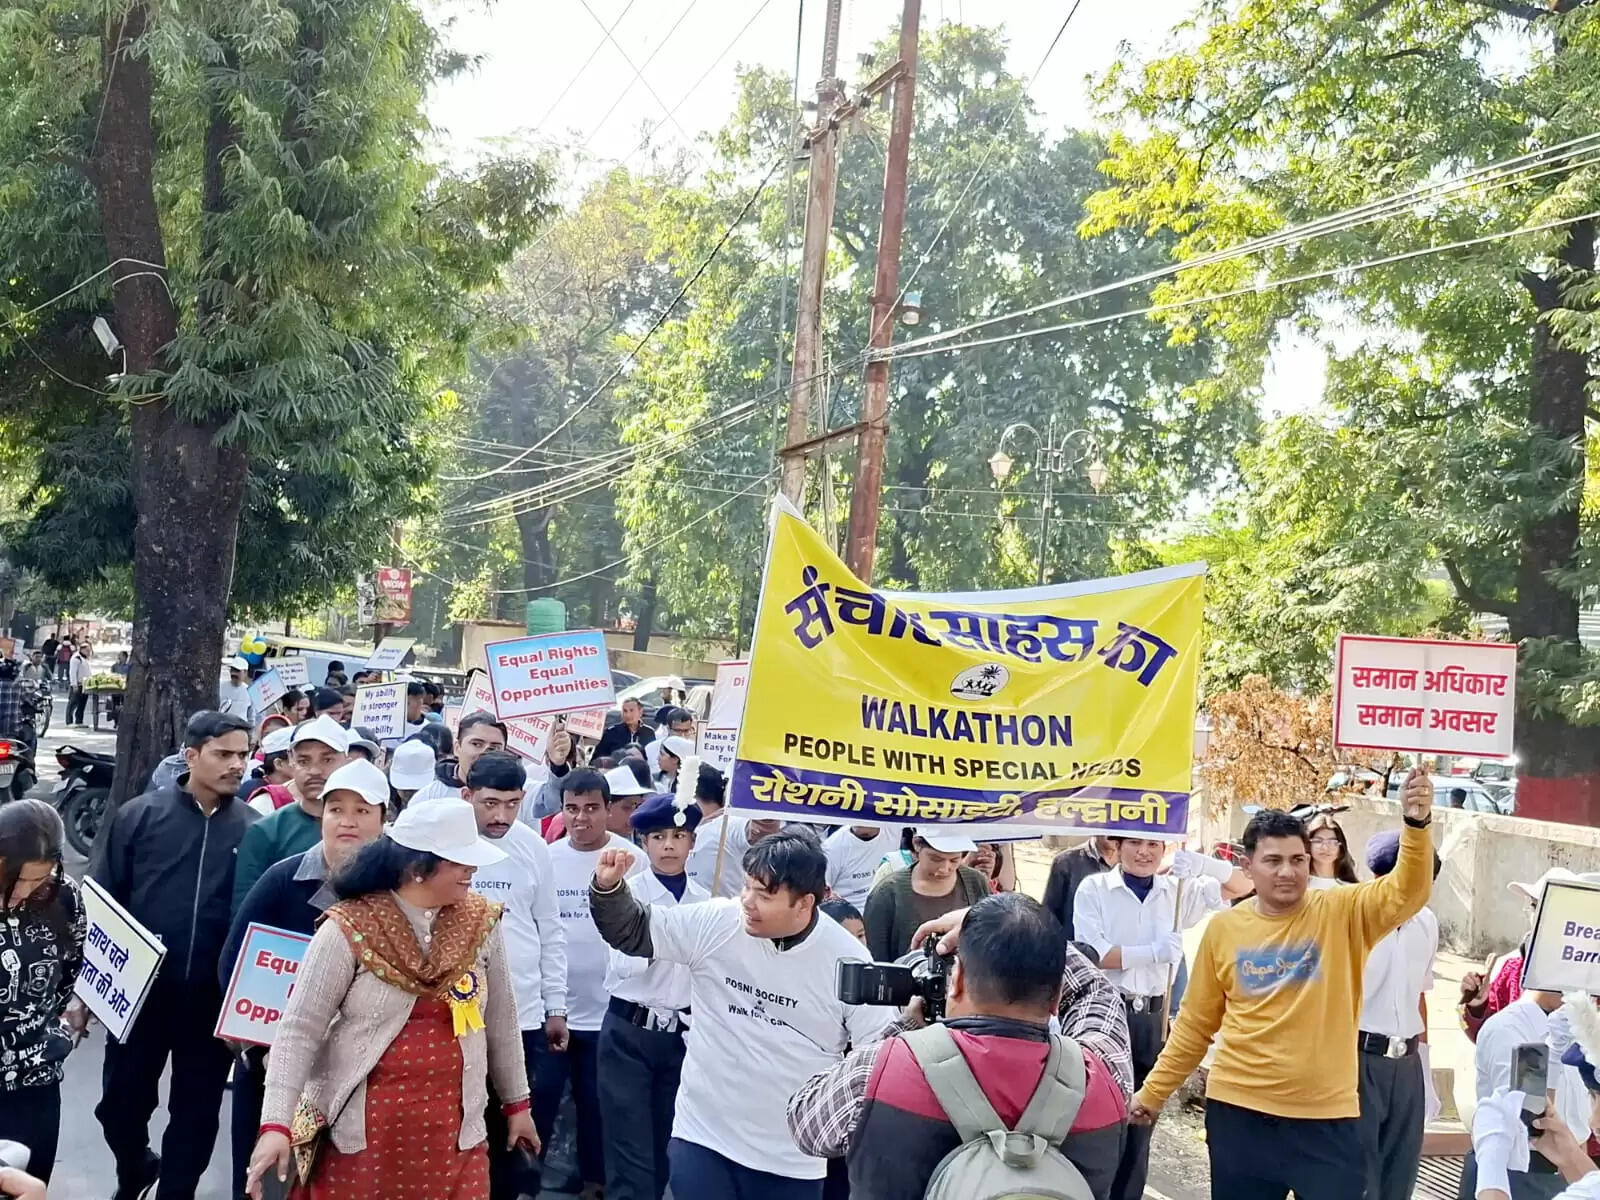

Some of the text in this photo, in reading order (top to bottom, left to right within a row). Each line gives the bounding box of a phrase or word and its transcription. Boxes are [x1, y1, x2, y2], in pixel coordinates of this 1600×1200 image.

[498, 646, 598, 668] Equal Rights
[1097, 621, 1178, 687] का
[529, 664, 574, 681] Equal
[1351, 665, 1508, 696] समान अधिकार
[365, 688, 397, 700] My ability
[501, 678, 608, 703] Opportunities
[360, 701, 398, 711] is stronger
[363, 714, 392, 723] than my
[861, 693, 1073, 747] WALKATHON
[1357, 704, 1498, 733] समान अवसर
[374, 725, 393, 735] bility
[704, 731, 728, 741] Make
[704, 742, 724, 753] Easy
[784, 733, 1142, 780] PEOPLE WITH SPECIAL NEEDS
[750, 768, 867, 812] रोशनी
[475, 881, 512, 891] SOCIETY
[88, 922, 111, 955] साथ
[96, 972, 113, 1000] की
[108, 987, 131, 1019] ओर
[755, 988, 798, 1009] SOCIETY
[235, 998, 283, 1025] Opp
[728, 1004, 749, 1017] Walk
